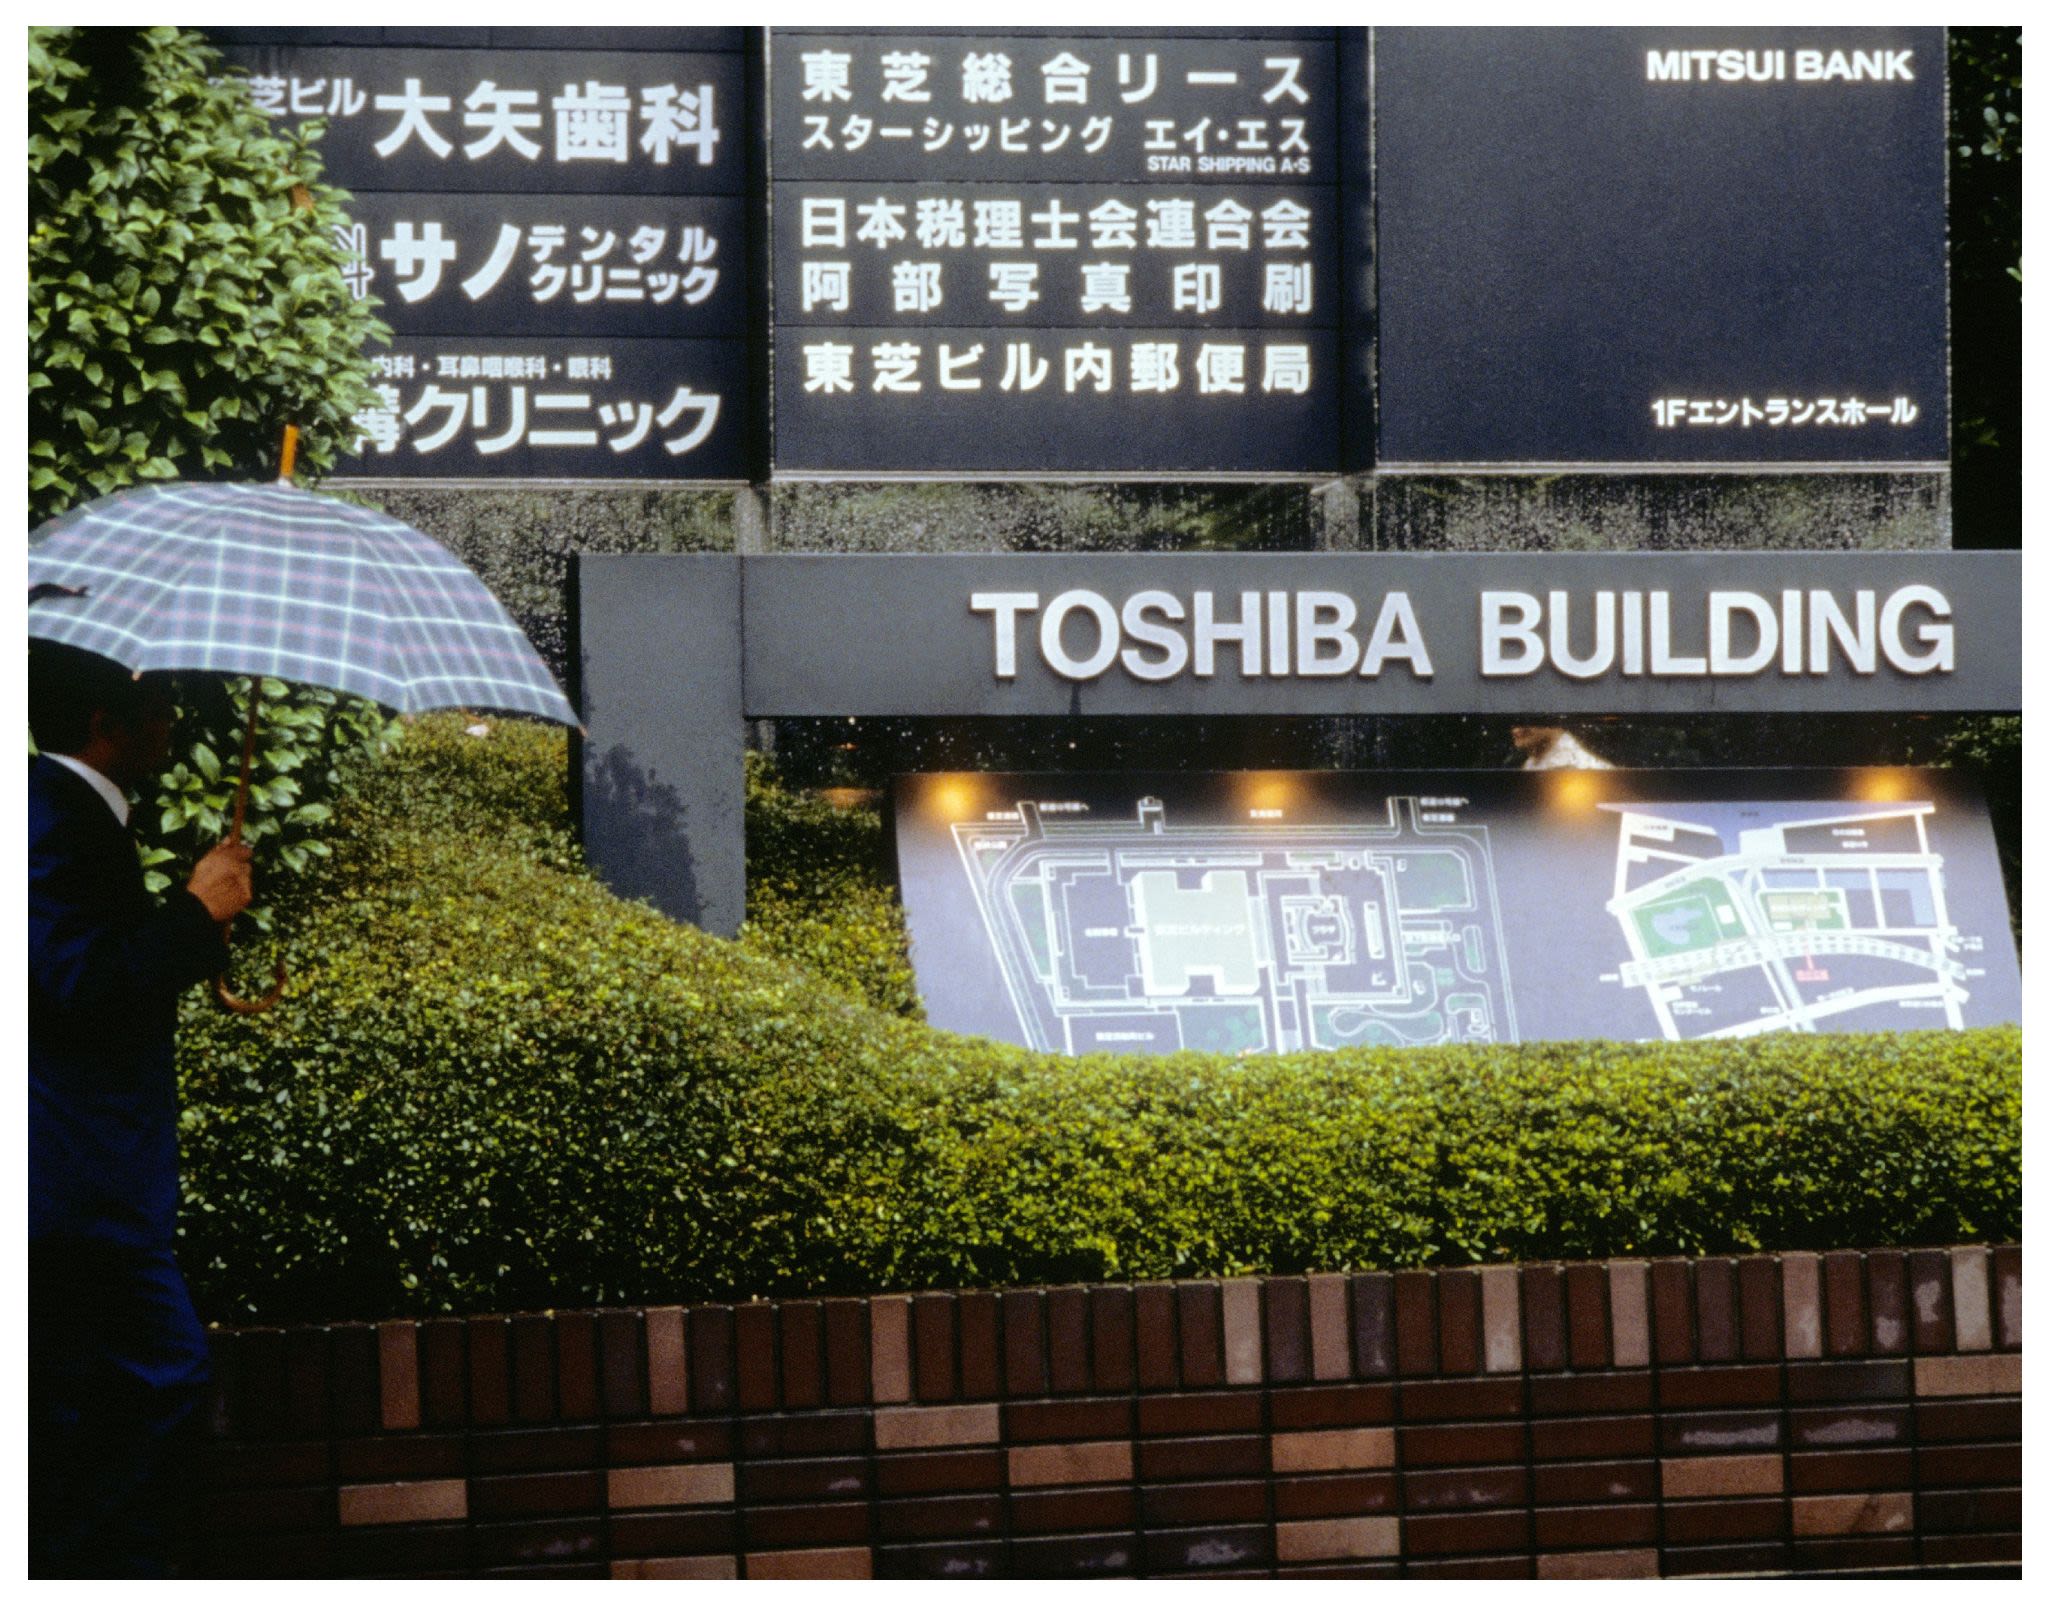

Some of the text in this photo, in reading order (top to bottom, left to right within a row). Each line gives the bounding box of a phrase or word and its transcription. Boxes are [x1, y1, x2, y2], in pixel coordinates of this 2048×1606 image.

[800, 50, 1309, 105] 東芝総合リース
[1646, 49, 1914, 82] MITSUI BANK
[207, 74, 720, 165] 芝ビル 大矢歯科
[802, 114, 1310, 154] スターシッピング エイ・エス
[1147, 156, 1191, 173] STAR
[1198, 157, 1276, 174] SHIPPING
[527, 224, 719, 262] デンタル
[801, 196, 1310, 250] 日本税理士会連合会
[380, 221, 522, 303] サノ
[530, 265, 719, 305] クリニック
[802, 261, 1312, 314] 阿部写真印刷
[803, 342, 1311, 394] 東芝ビル内郵便局
[1651, 397, 1918, 427] 1Fエントランスホール
[970, 584, 1957, 681] TOSHIBA BUILDING
